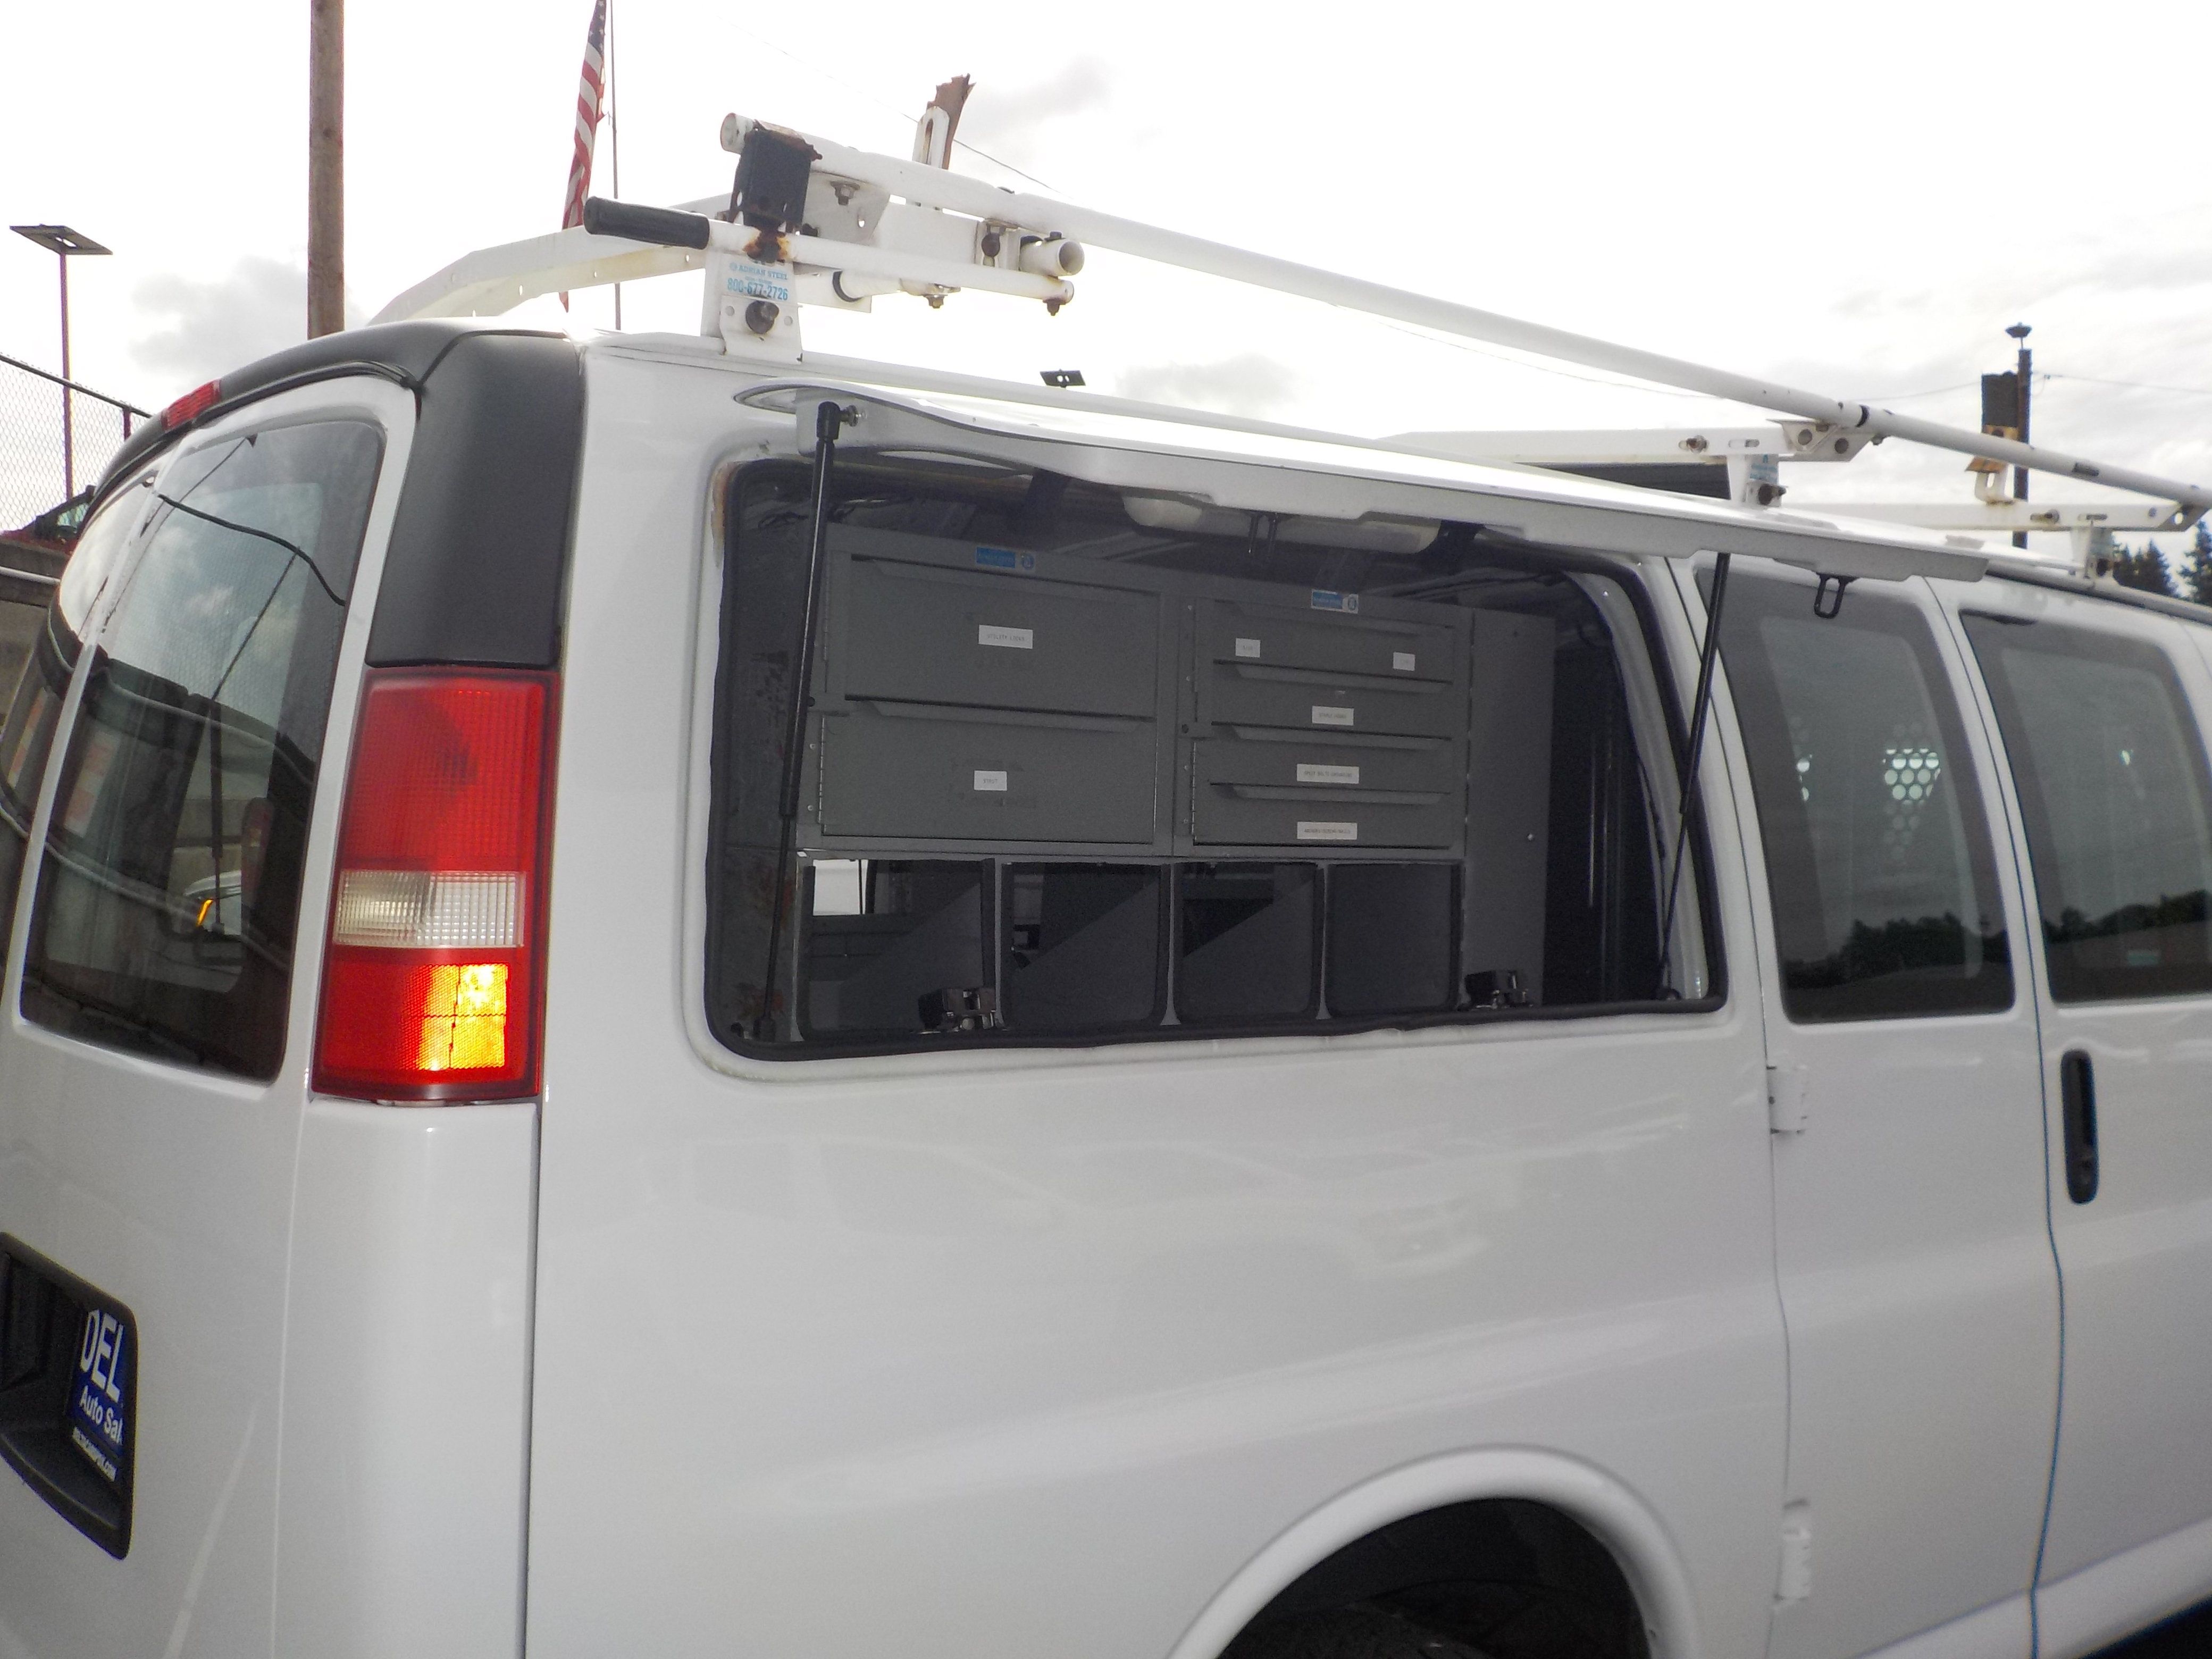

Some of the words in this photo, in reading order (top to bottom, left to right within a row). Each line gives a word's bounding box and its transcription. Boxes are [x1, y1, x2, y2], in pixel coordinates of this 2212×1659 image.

[739, 265, 766, 275] ADRIAN
[767, 271, 788, 280] STEEL
[80, 1385, 103, 1426] Auto
[104, 1407, 123, 1446] Sal
